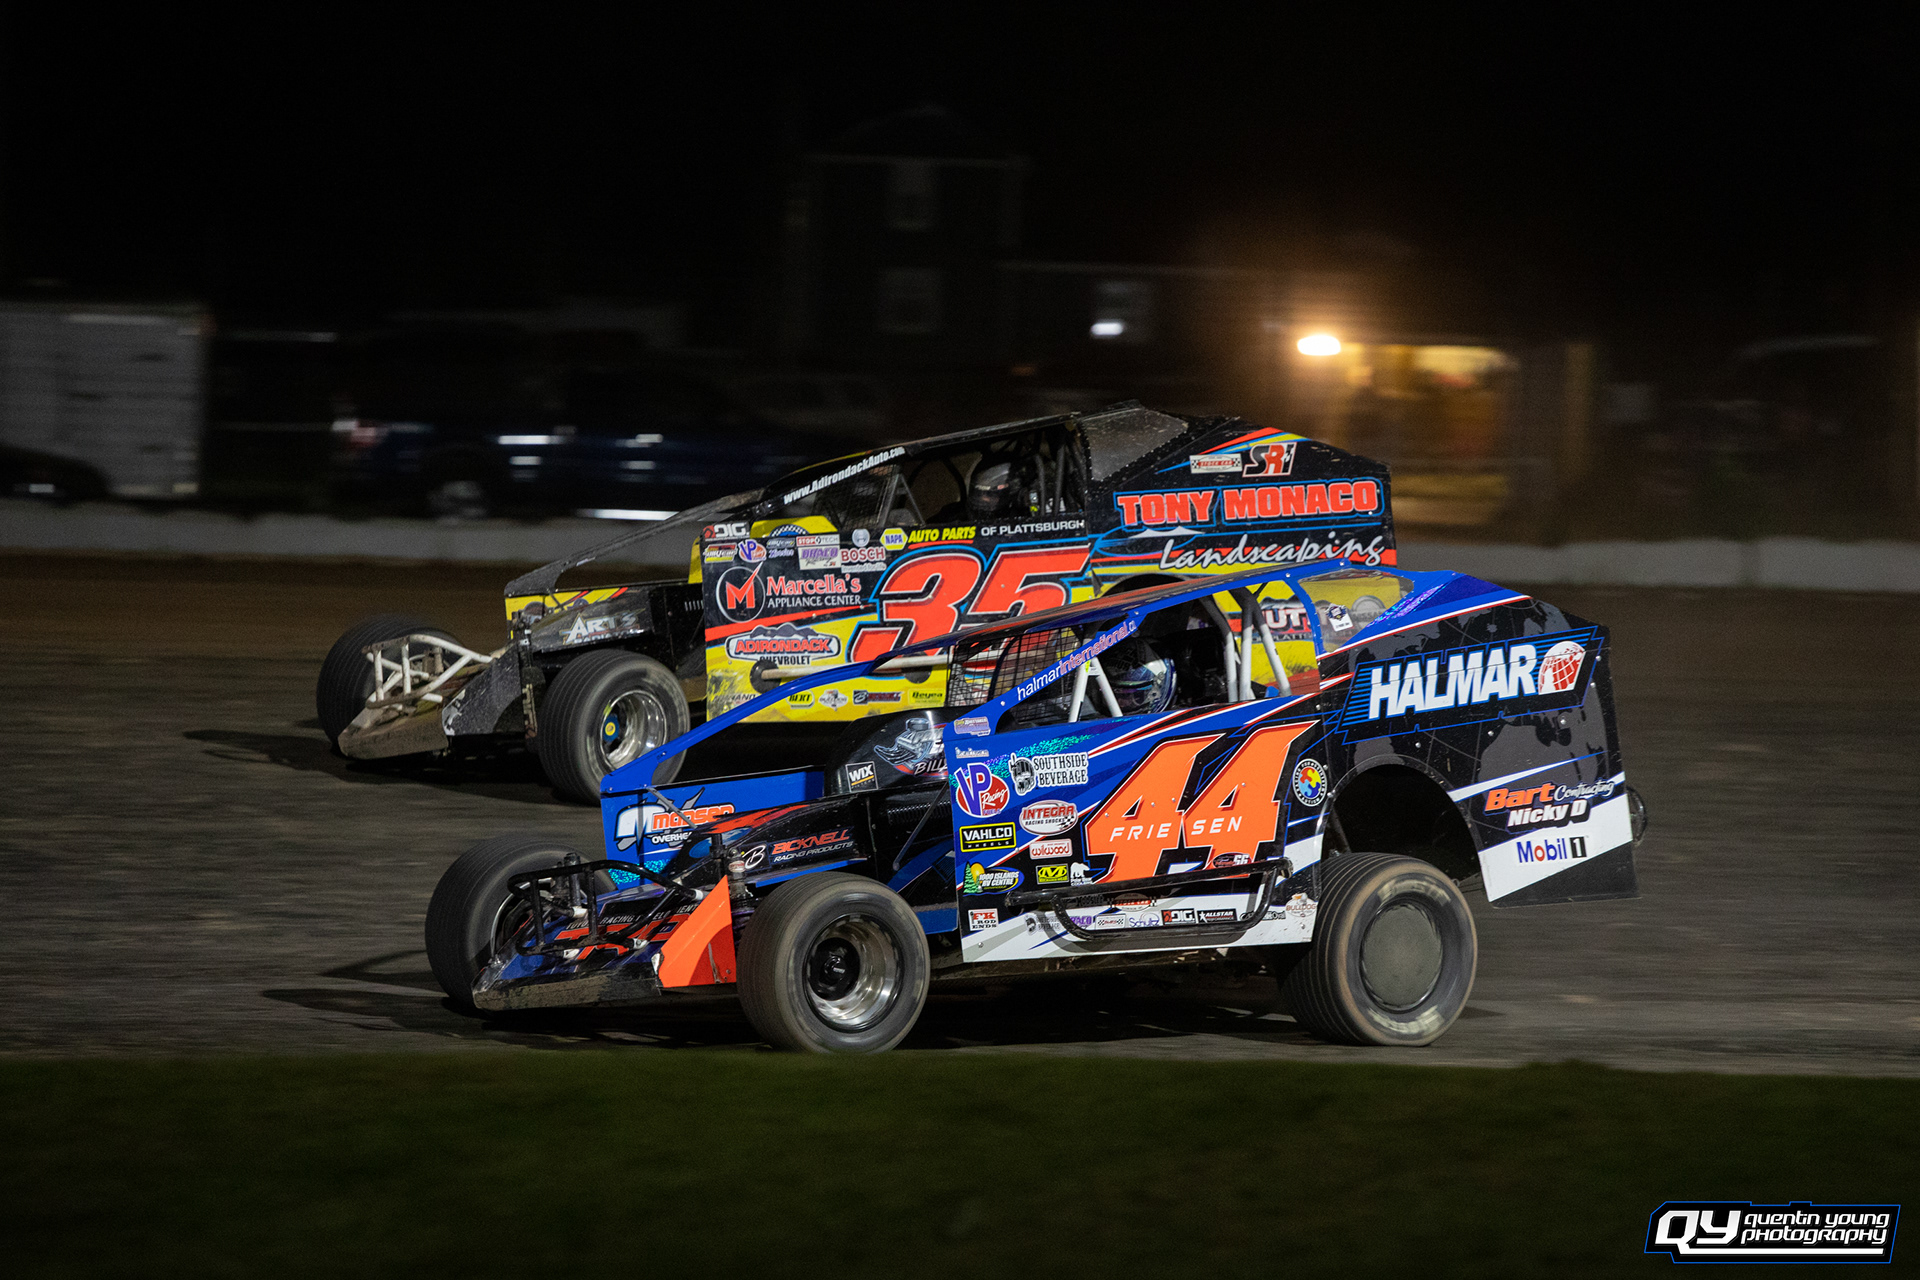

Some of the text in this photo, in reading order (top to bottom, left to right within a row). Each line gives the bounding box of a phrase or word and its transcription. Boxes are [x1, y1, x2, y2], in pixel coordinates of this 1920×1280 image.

[783, 446, 905, 505] www.AdirondackAuto.com
[1117, 480, 1378, 526] TONY MONACO
[884, 520, 1086, 546] NAPA AUTO PARTS OF PLATTSBURGH
[739, 540, 757, 561] VP
[841, 547, 886, 562] BOSCH
[1158, 531, 1385, 569] Landscaping
[766, 574, 862, 597] Marcella's
[767, 595, 862, 609] APPLIANCE CENTER
[849, 546, 1092, 668] 35
[735, 638, 832, 655] ADIRONDACK
[1368, 643, 1539, 720] HALMAR
[849, 764, 875, 782] WIX
[1033, 755, 1088, 770] SOUTHSIDE
[1039, 771, 1088, 786] BEVERAGE
[955, 763, 991, 816] VP
[982, 788, 1008, 808] Racing
[1086, 720, 1321, 880] 44
[1485, 780, 1616, 811] Bart Contracting
[1022, 805, 1075, 820] INTEGRA
[1507, 799, 1588, 827] Nicky D
[651, 832, 692, 844] OVERHE
[771, 828, 851, 855] BICKNELL
[963, 826, 1013, 841] VAHLCO
[967, 840, 1010, 848] WHEELS
[773, 841, 854, 863] RACING PRODUCTS
[1031, 842, 1070, 857] wilwood
[1516, 837, 1585, 864] Mobil 1
[1285, 903, 1317, 911] BULLDOG
[600, 914, 634, 925] RACING
